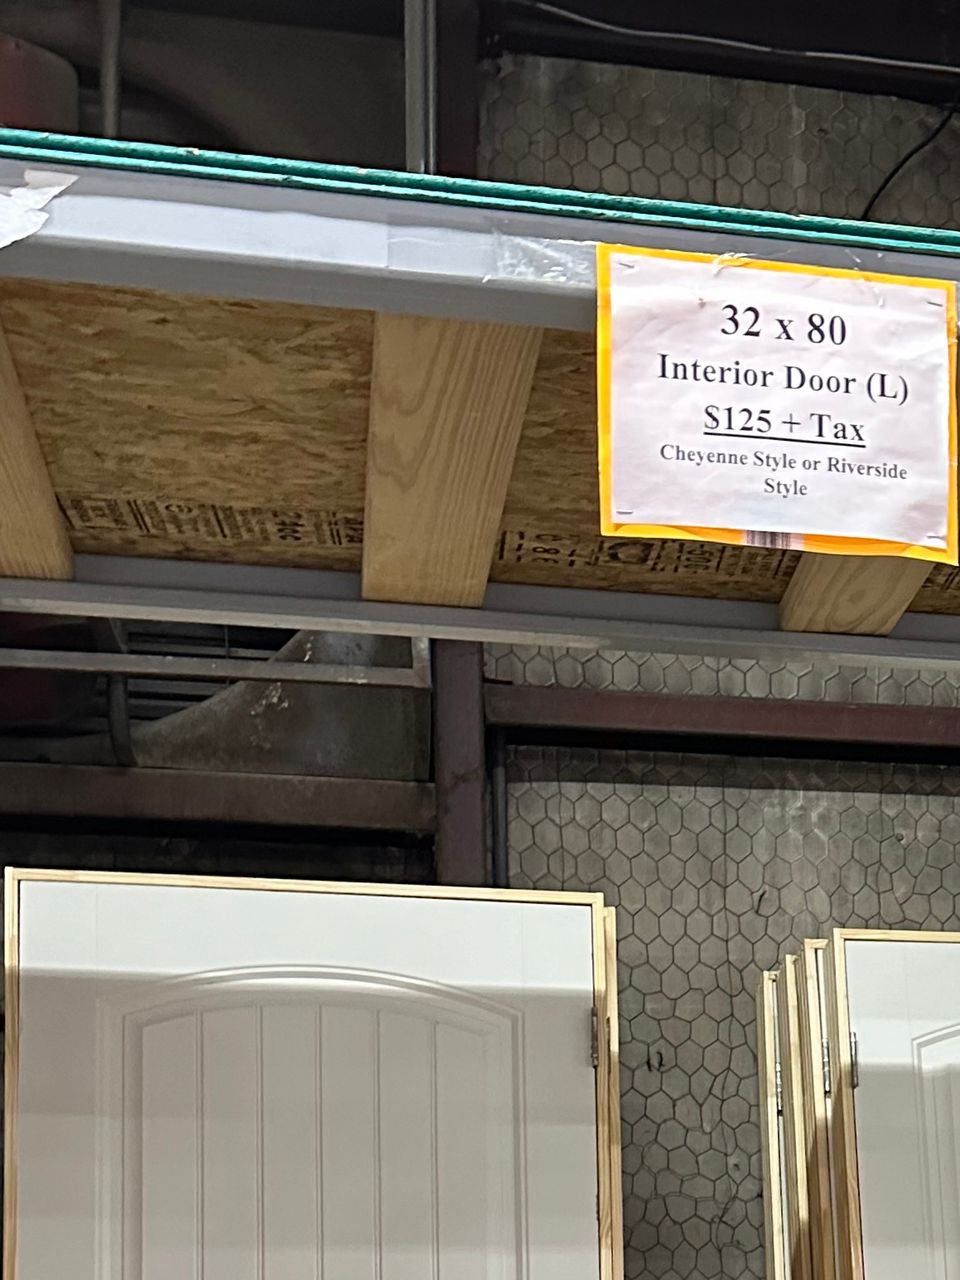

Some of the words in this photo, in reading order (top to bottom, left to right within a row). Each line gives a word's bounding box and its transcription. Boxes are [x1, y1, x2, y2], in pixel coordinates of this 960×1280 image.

[720, 304, 762, 337] 32
[775, 318, 796, 342] x
[807, 312, 847, 346] 80
[656, 353, 774, 388] Interior
[783, 365, 857, 394] Door
[866, 372, 909, 405] (L)
[703, 405, 772, 434] $125
[781, 413, 801, 433] +
[810, 412, 866, 442] Tax
[660, 443, 749, 467] Cheyenne
[753, 450, 797, 472] Style
[802, 457, 822, 472] or
[826, 457, 908, 480] Riverside
[763, 478, 808, 499] Style
